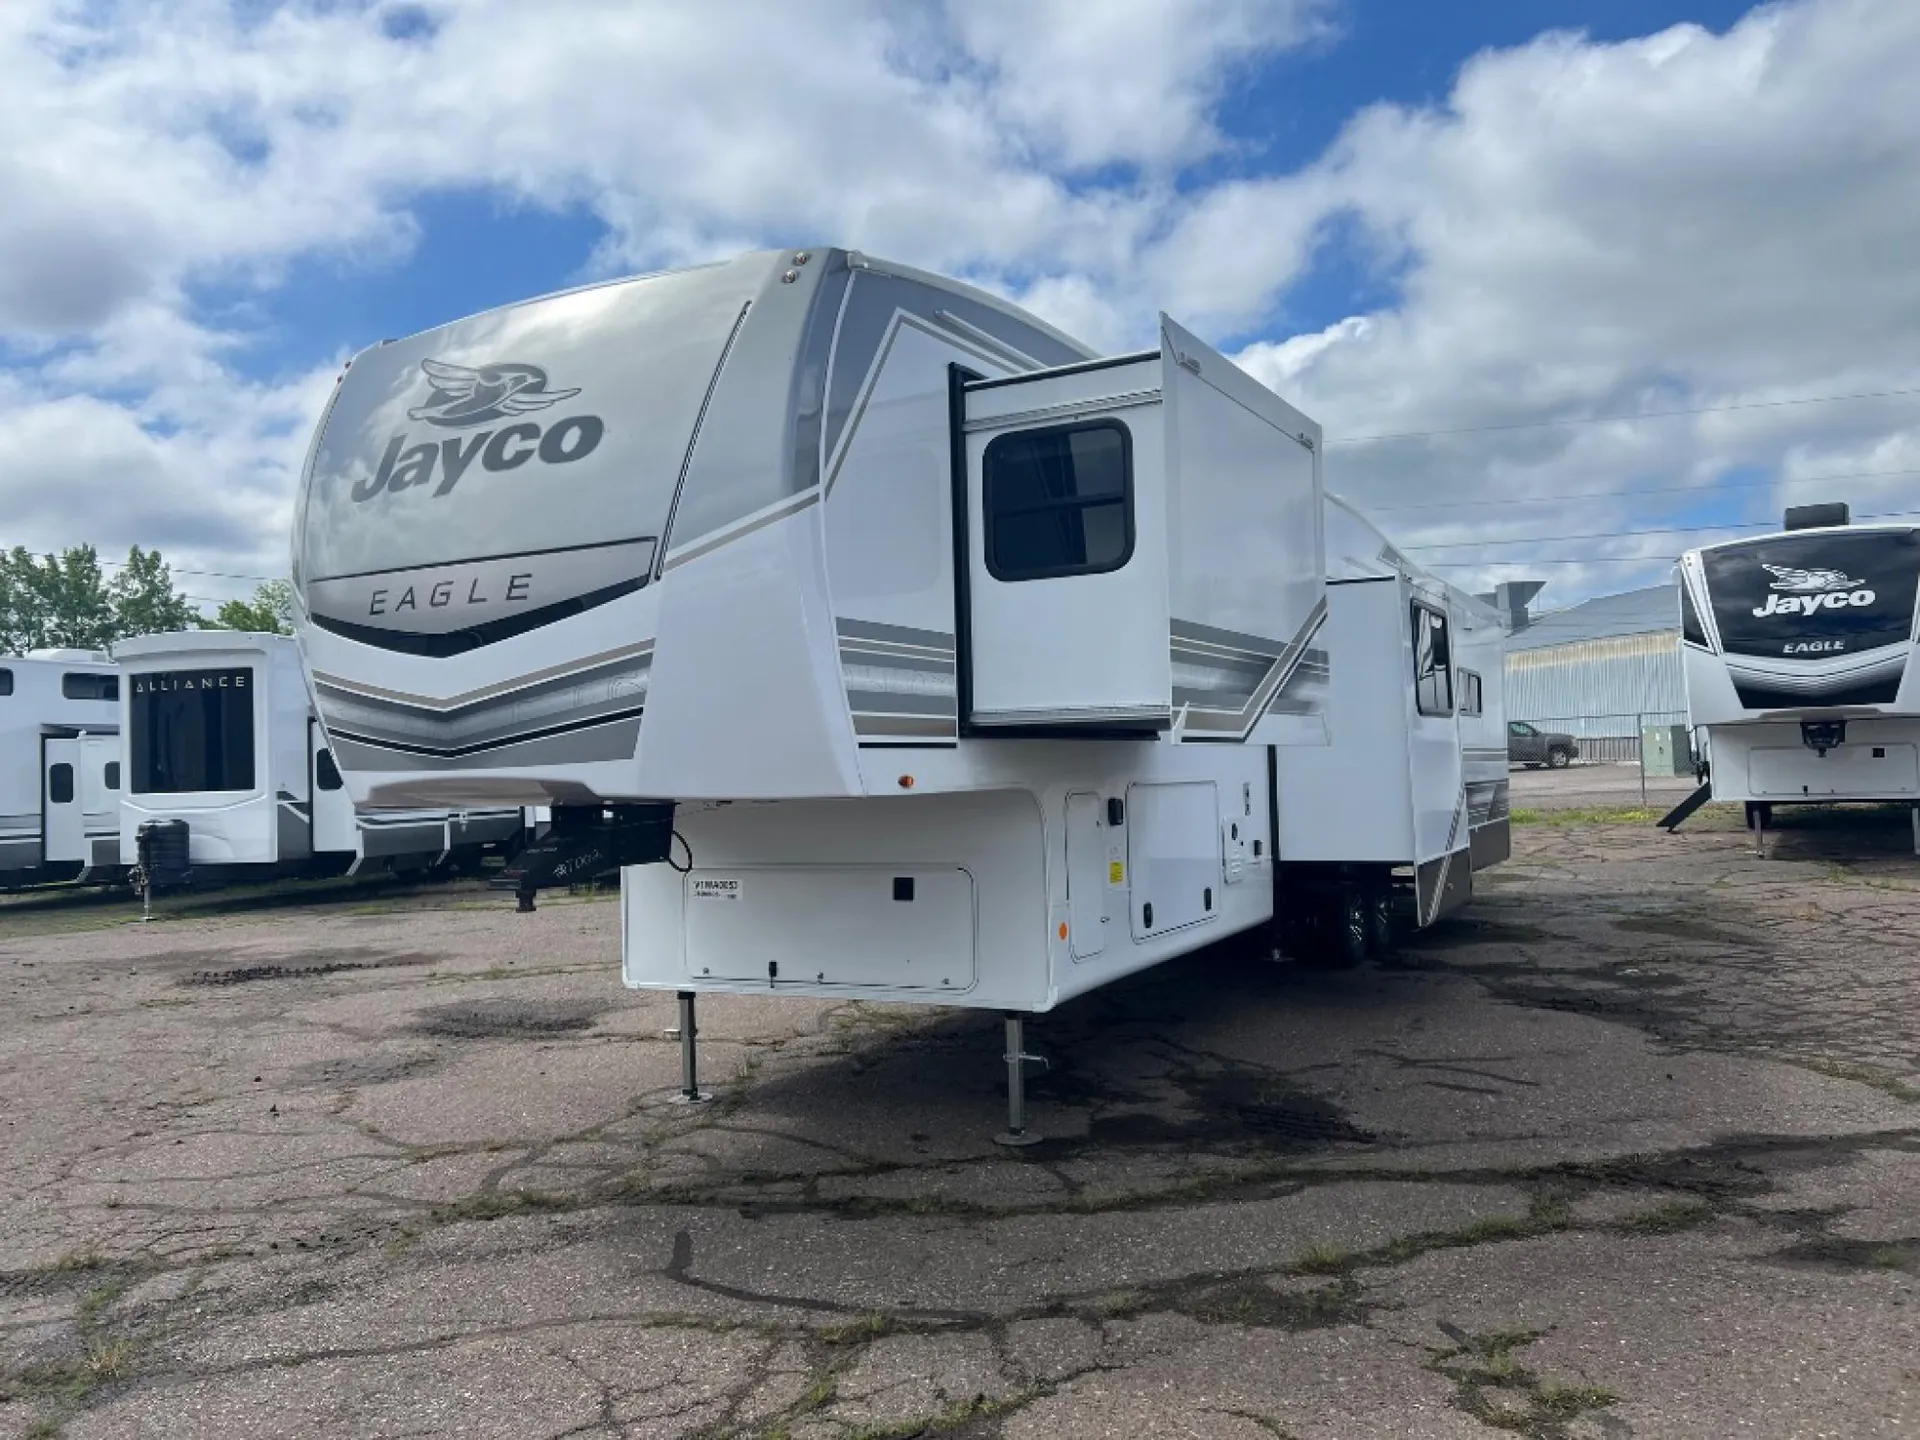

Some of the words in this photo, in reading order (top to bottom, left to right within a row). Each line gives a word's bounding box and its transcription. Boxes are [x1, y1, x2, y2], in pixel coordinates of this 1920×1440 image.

[352, 414, 604, 503] Jayco
[369, 572, 533, 616] EAGLE
[1752, 589, 1876, 618] Jayco
[1783, 639, 1845, 654] EAGLE
[136, 676, 245, 693] ALLIANCE
